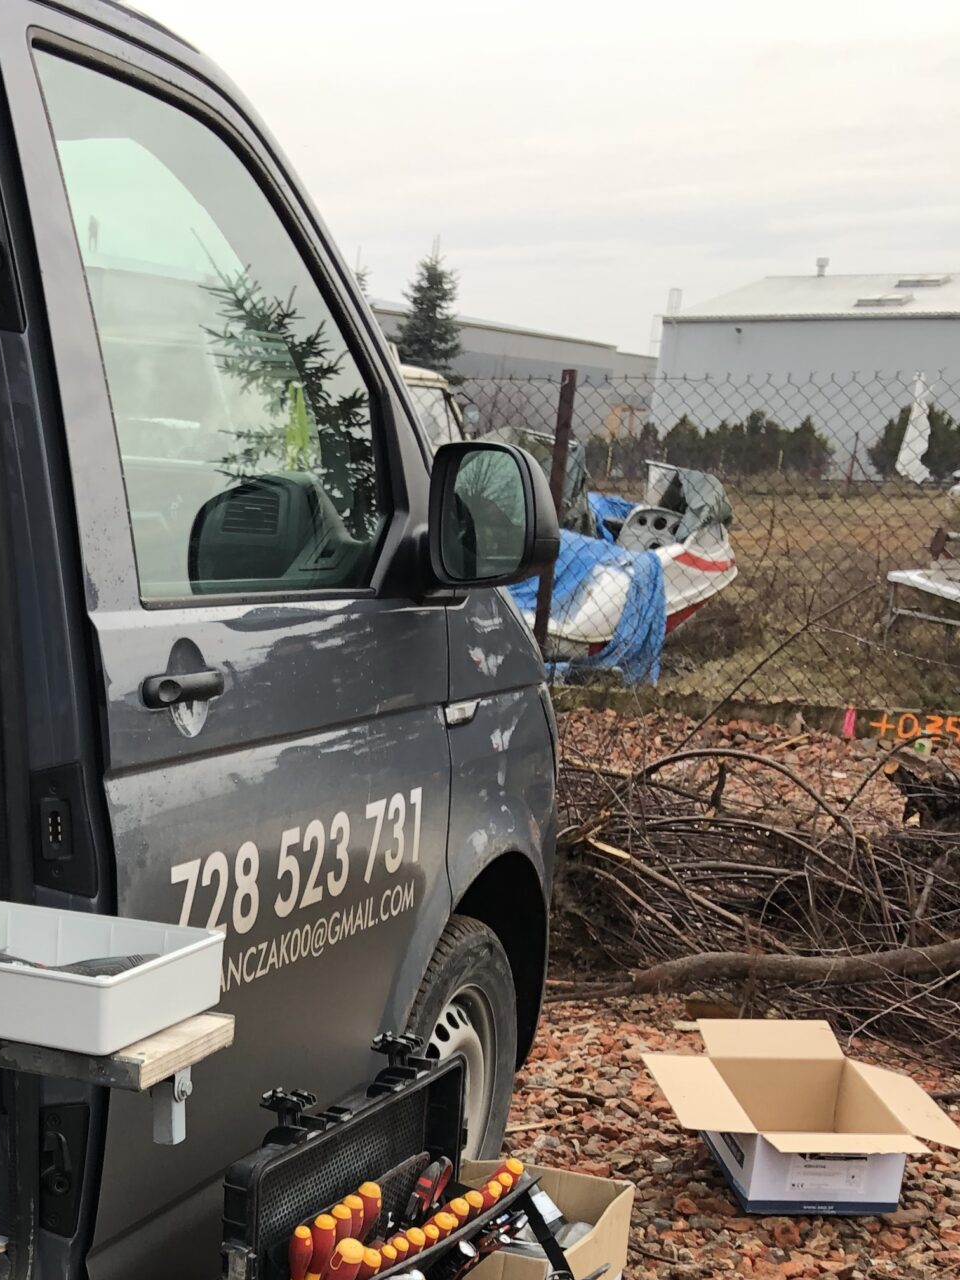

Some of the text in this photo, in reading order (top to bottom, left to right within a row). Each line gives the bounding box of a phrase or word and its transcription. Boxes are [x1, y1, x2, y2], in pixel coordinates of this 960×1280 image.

[170, 786, 422, 935] 728 523 731
